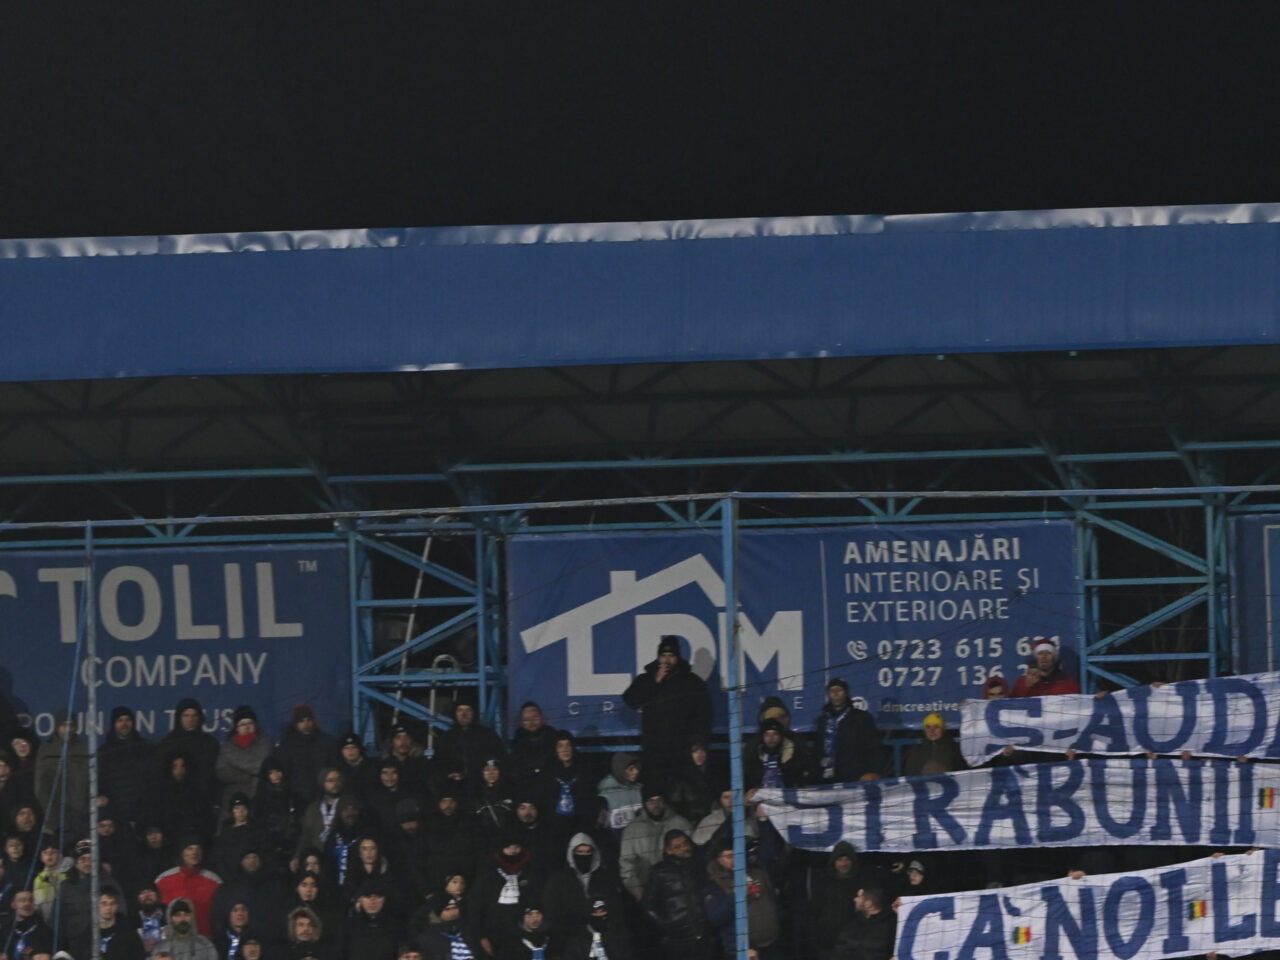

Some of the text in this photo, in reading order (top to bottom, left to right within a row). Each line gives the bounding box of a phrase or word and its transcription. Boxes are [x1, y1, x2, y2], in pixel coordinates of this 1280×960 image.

[843, 533, 1021, 564] AMENAJĂRI
[845, 568, 1004, 593] INTERIOARE
[38, 562, 303, 643] TOLIL
[847, 598, 1010, 623] EXTERIOARE
[877, 638, 941, 660] 0723
[955, 637, 1003, 658] 615
[81, 651, 268, 688] COMPANY
[878, 666, 942, 687] 0727
